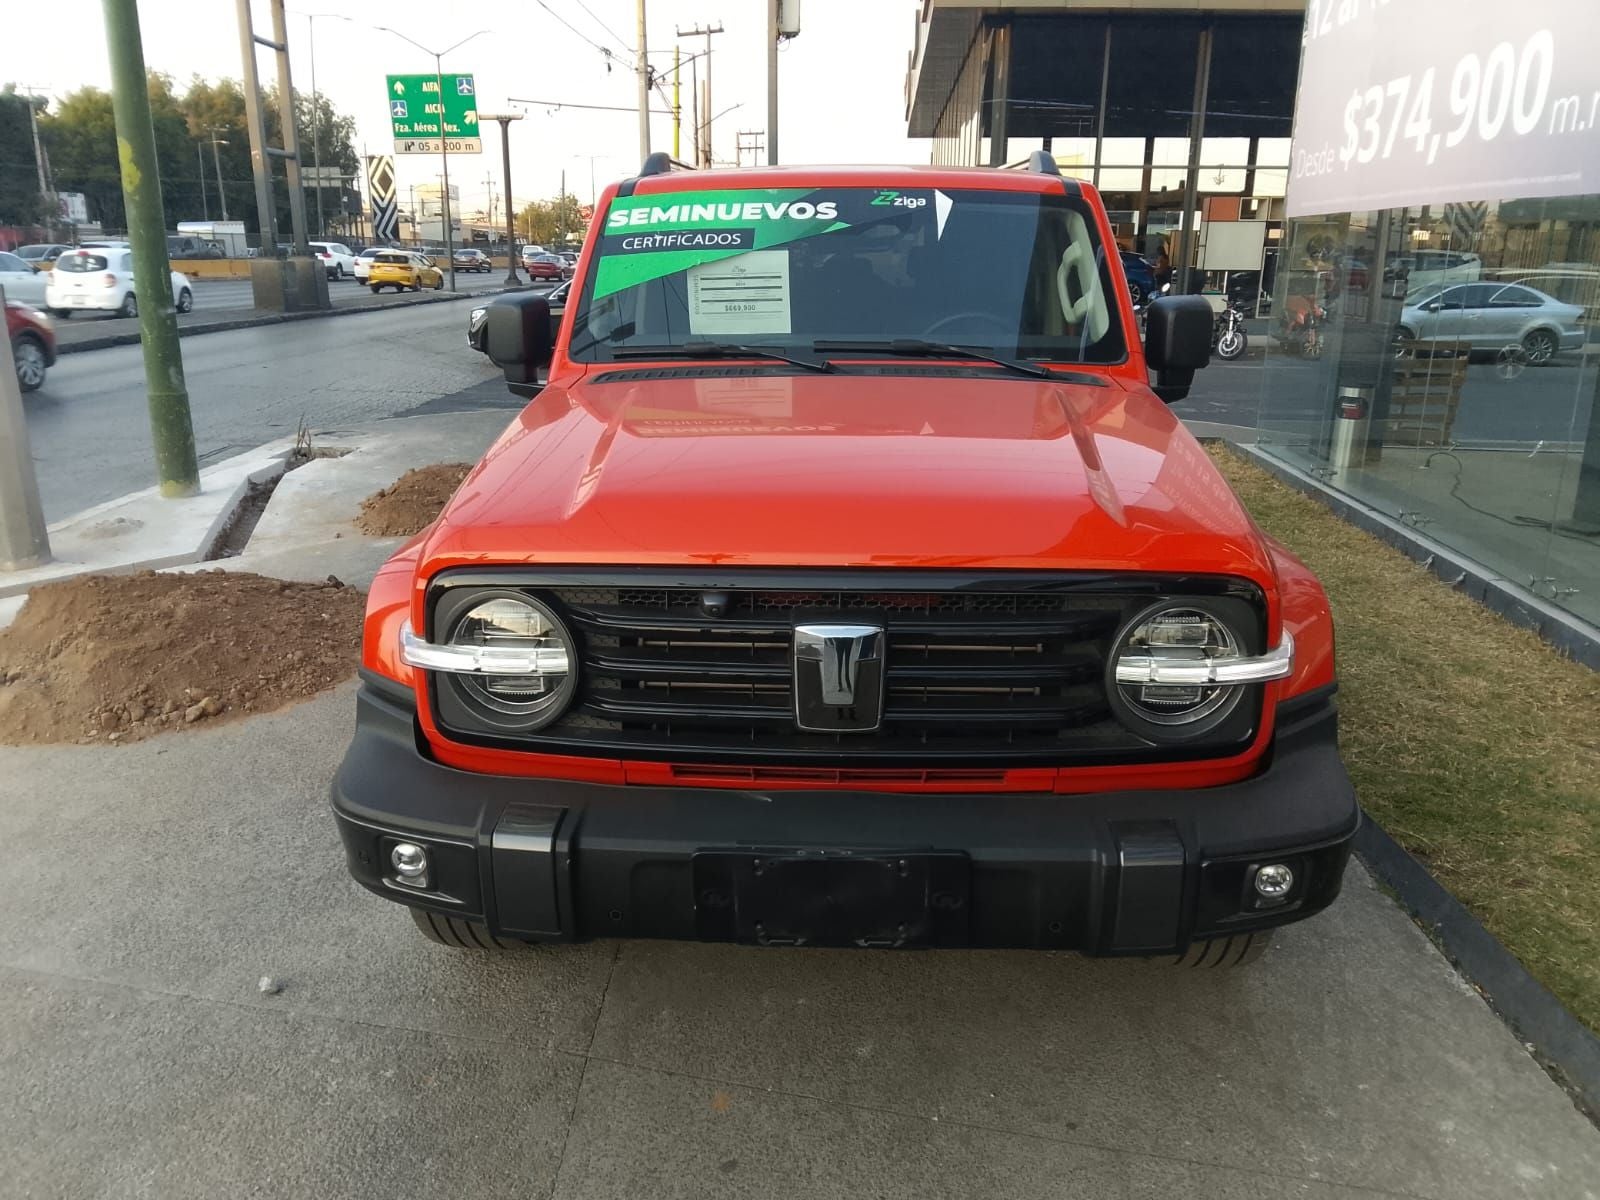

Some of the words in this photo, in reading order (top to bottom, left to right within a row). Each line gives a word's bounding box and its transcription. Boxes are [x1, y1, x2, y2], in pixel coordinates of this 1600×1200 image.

[1296, 146, 1335, 178] Desde
[1340, 29, 1554, 171] $374,900
[394, 122, 412, 132] Fza.
[413, 121, 438, 132] Aérea
[418, 142, 431, 151] 05
[433, 143, 440, 151] a
[464, 143, 474, 151] m
[608, 201, 838, 227] SEMINUEVOS
[622, 232, 741, 250] CERTIFICADOS
